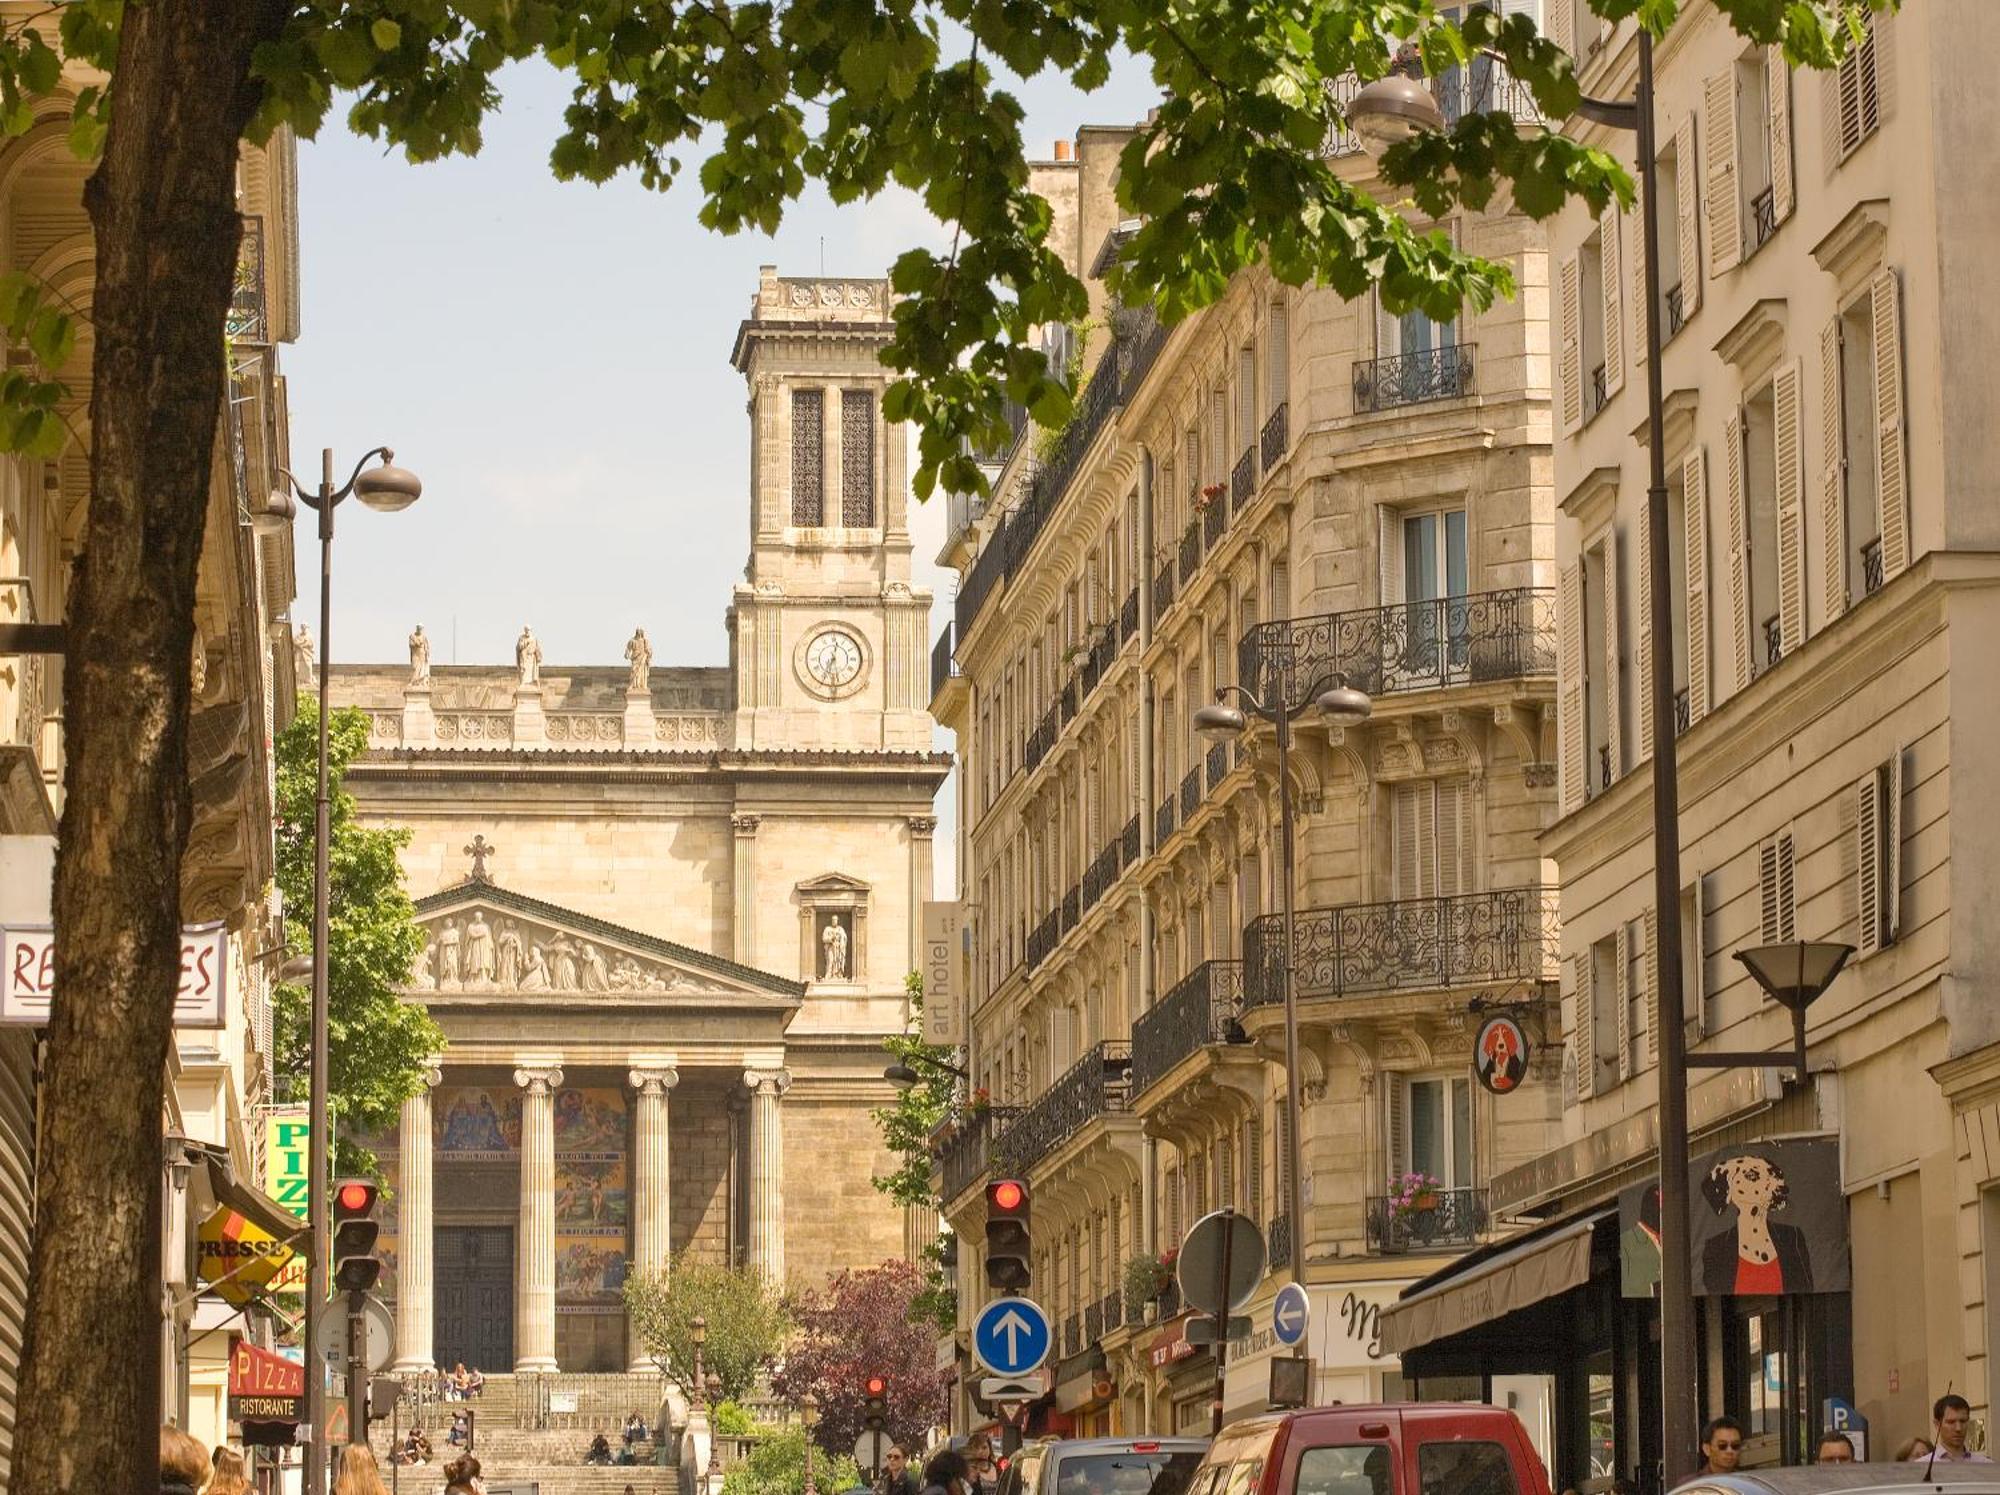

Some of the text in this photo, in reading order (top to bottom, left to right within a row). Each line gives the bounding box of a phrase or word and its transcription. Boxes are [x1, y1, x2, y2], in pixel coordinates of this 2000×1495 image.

[927, 940, 949, 1036] art hotel
[237, 1351, 299, 1390] PIZZA
[240, 1398, 295, 1416] RISTORANTE
[1834, 1407, 1848, 1430] P
